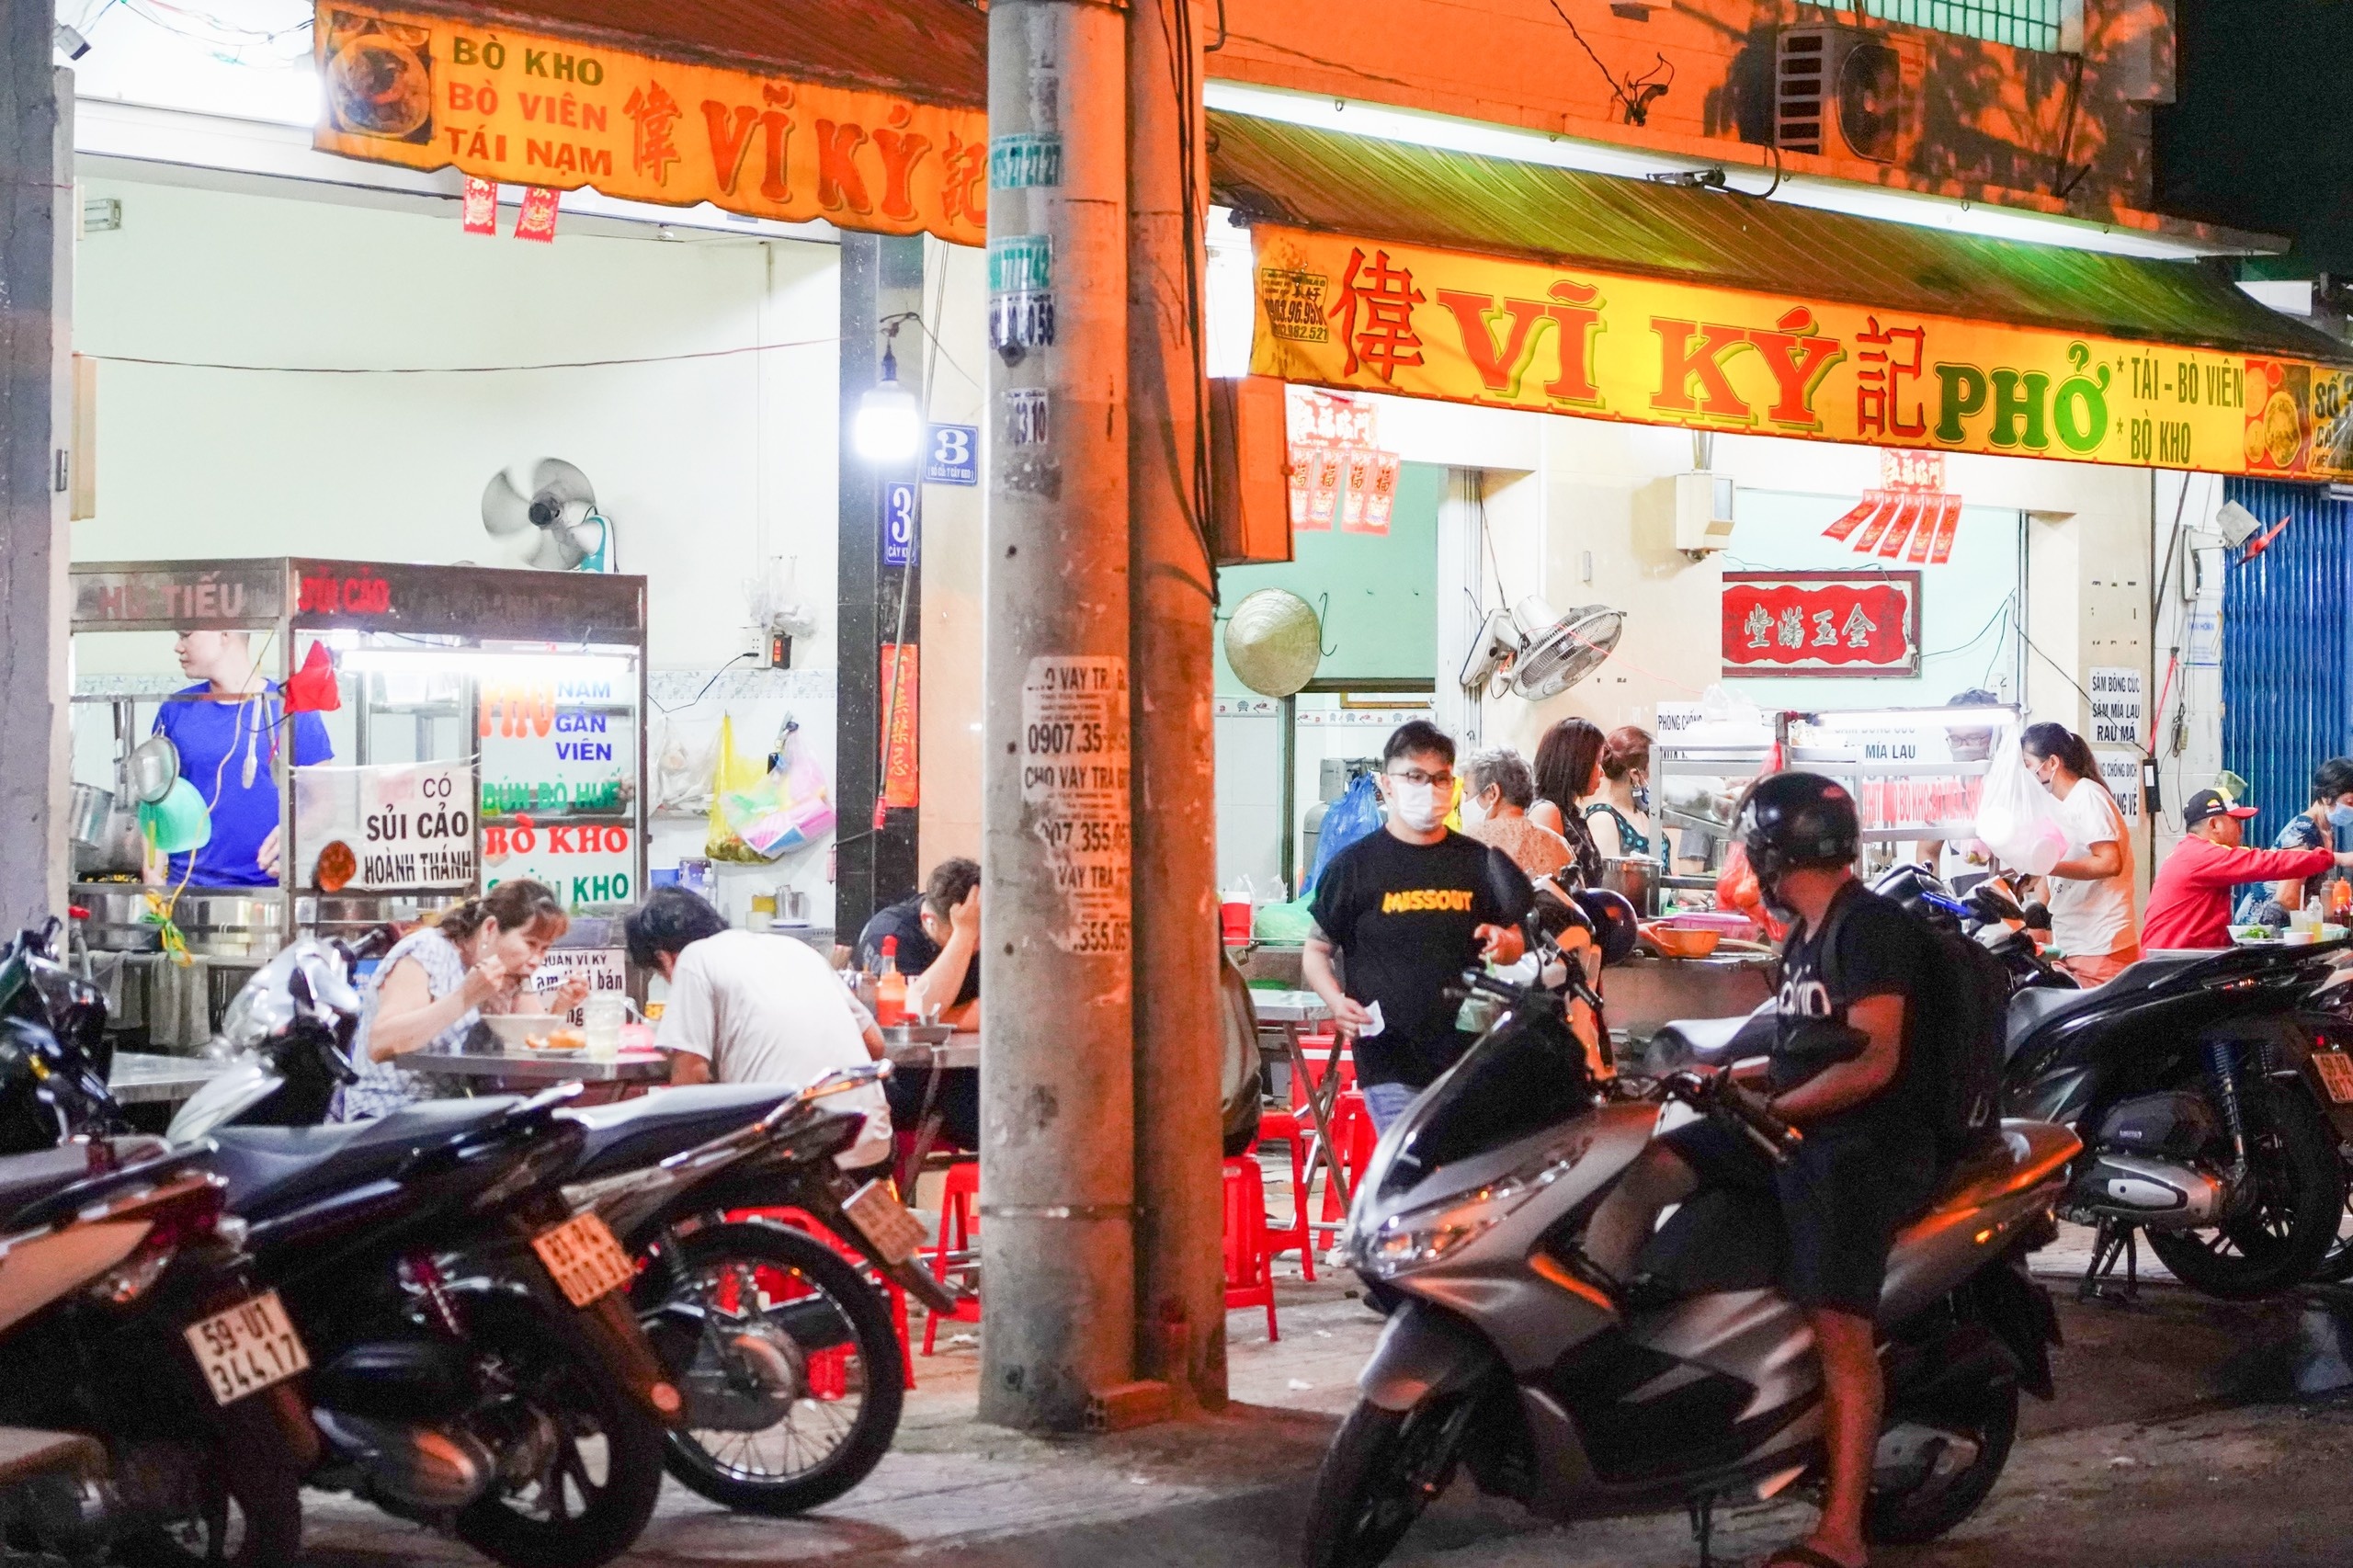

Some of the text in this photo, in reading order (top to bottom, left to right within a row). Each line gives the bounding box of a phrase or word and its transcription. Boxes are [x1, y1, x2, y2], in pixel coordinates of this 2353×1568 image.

[453, 34, 604, 86] BÒ KHO
[449, 79, 608, 132] BÒ VIÊN
[445, 124, 506, 163] TÁI
[1437, 279, 1608, 410] VĨ
[1856, 314, 1927, 438] 記
[2131, 348, 2160, 400] TÁI
[2177, 353, 2200, 404] BÒ
[2206, 357, 2244, 409] VIÊN
[1933, 340, 2112, 455] PHỞ
[935, 428, 970, 465] 3
[2131, 409, 2192, 465] BÒ KHO
[892, 486, 912, 543] 3
[2126, 704, 2141, 719] LAU
[555, 737, 612, 761] VIÊN
[1892, 744, 1916, 759] LAU
[2097, 722, 2136, 742] RAU MÁ
[423, 772, 452, 798] CÓ
[1059, 766, 1087, 789] VAY
[367, 801, 469, 841] SỦI CẢO
[485, 812, 629, 855] BÒ KHO
[365, 844, 472, 884] HOÀNH THÁNH
[573, 873, 629, 903] KHO
[598, 970, 622, 990] bán
